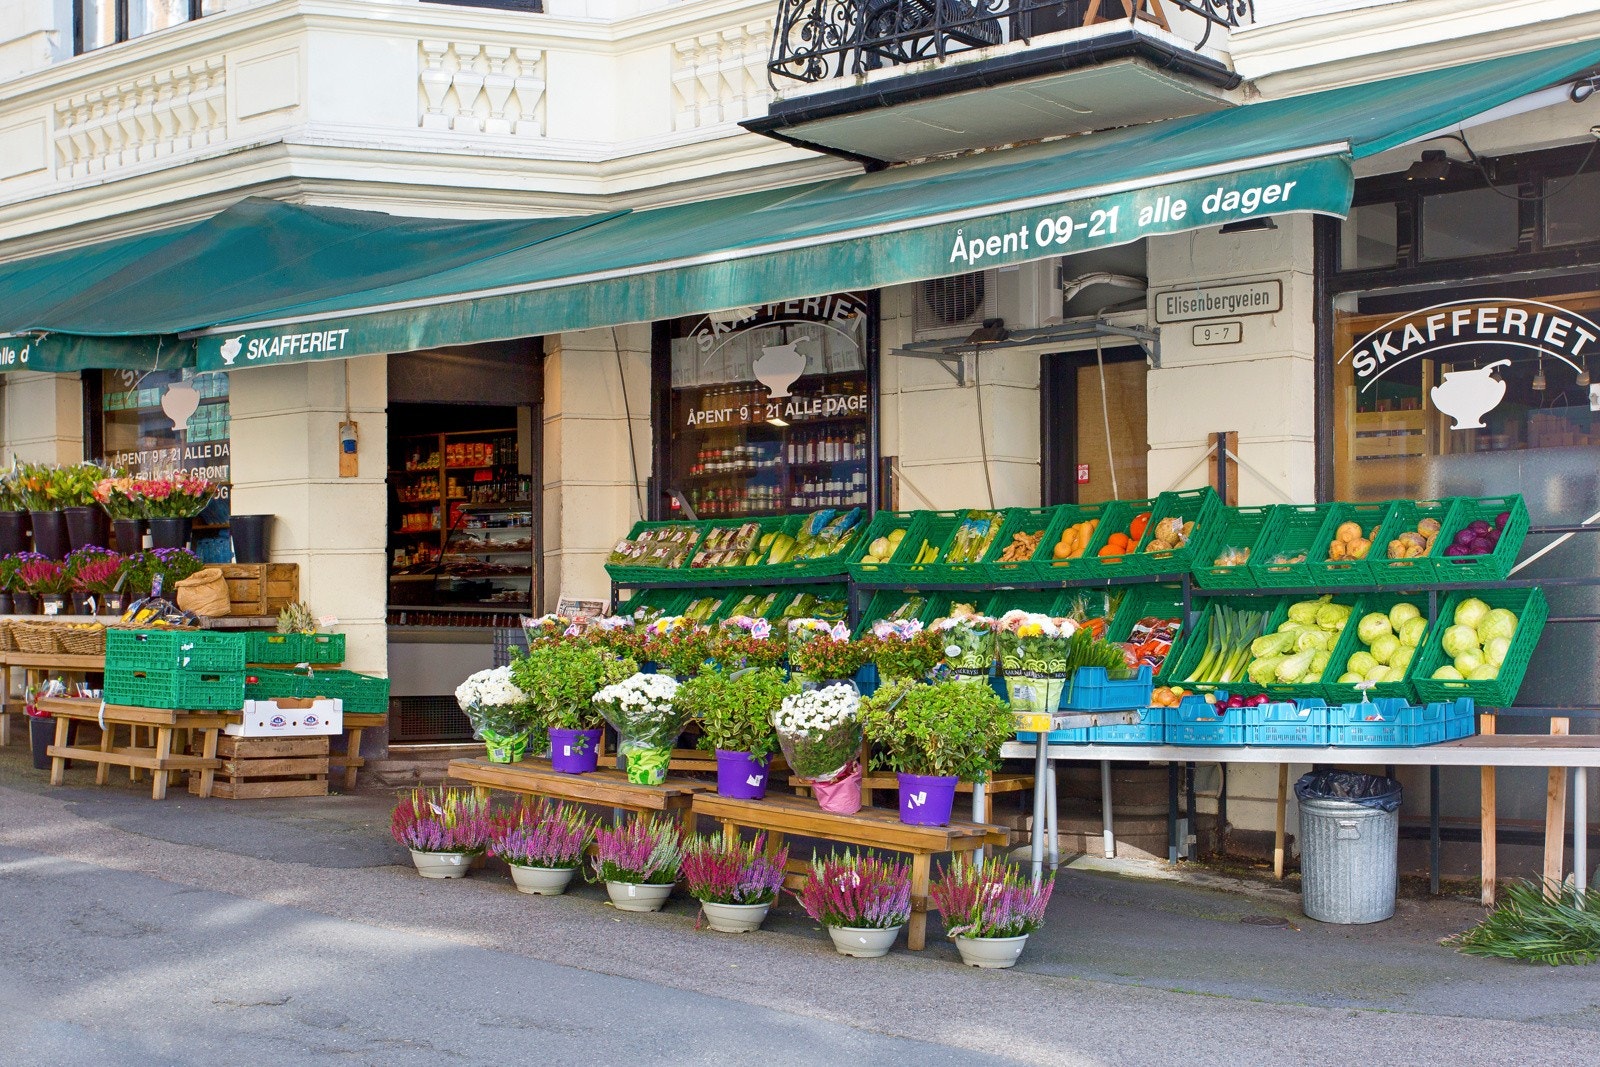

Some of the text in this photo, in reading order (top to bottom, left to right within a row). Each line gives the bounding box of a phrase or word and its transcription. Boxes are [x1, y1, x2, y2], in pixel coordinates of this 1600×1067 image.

[949, 181, 1297, 265] Åpent 09-21 alle dager
[1166, 289, 1270, 315] Elisenbergveien
[246, 328, 350, 360] SKAFFERIET
[1351, 307, 1597, 377] SKAFFERIET
[687, 408, 733, 426] ÅPENT
[739, 407, 749, 421] 9
[766, 404, 780, 419] 21
[784, 399, 822, 417] ALLE
[115, 450, 148, 466] ÅPENT
[184, 445, 212, 460] ALLE
